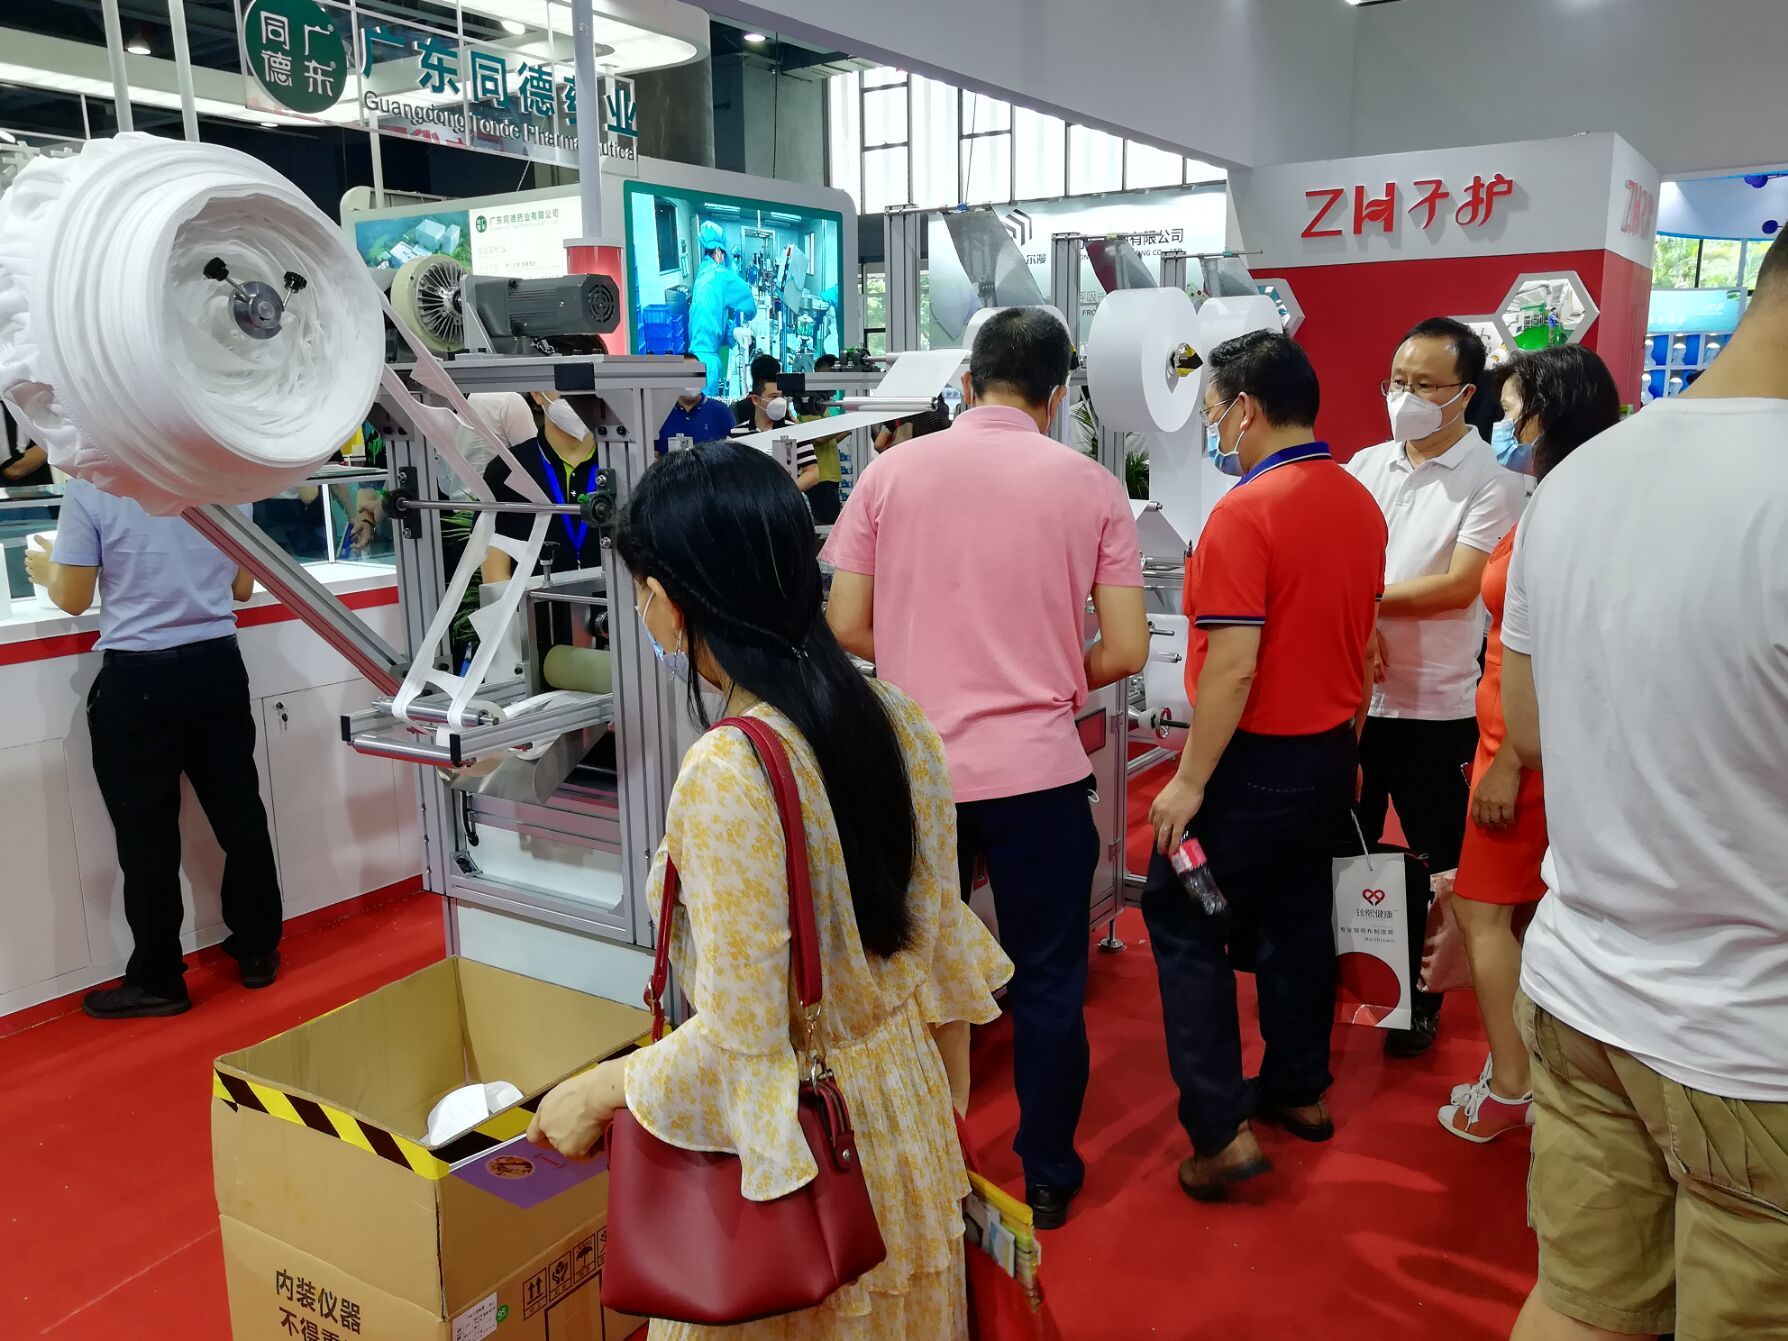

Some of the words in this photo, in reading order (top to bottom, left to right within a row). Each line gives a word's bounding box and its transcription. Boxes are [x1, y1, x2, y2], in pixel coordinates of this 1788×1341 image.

[363, 90, 465, 133] Guangdong
[469, 111, 521, 140] Tonde
[275, 1268, 361, 1335] 内装仪器
